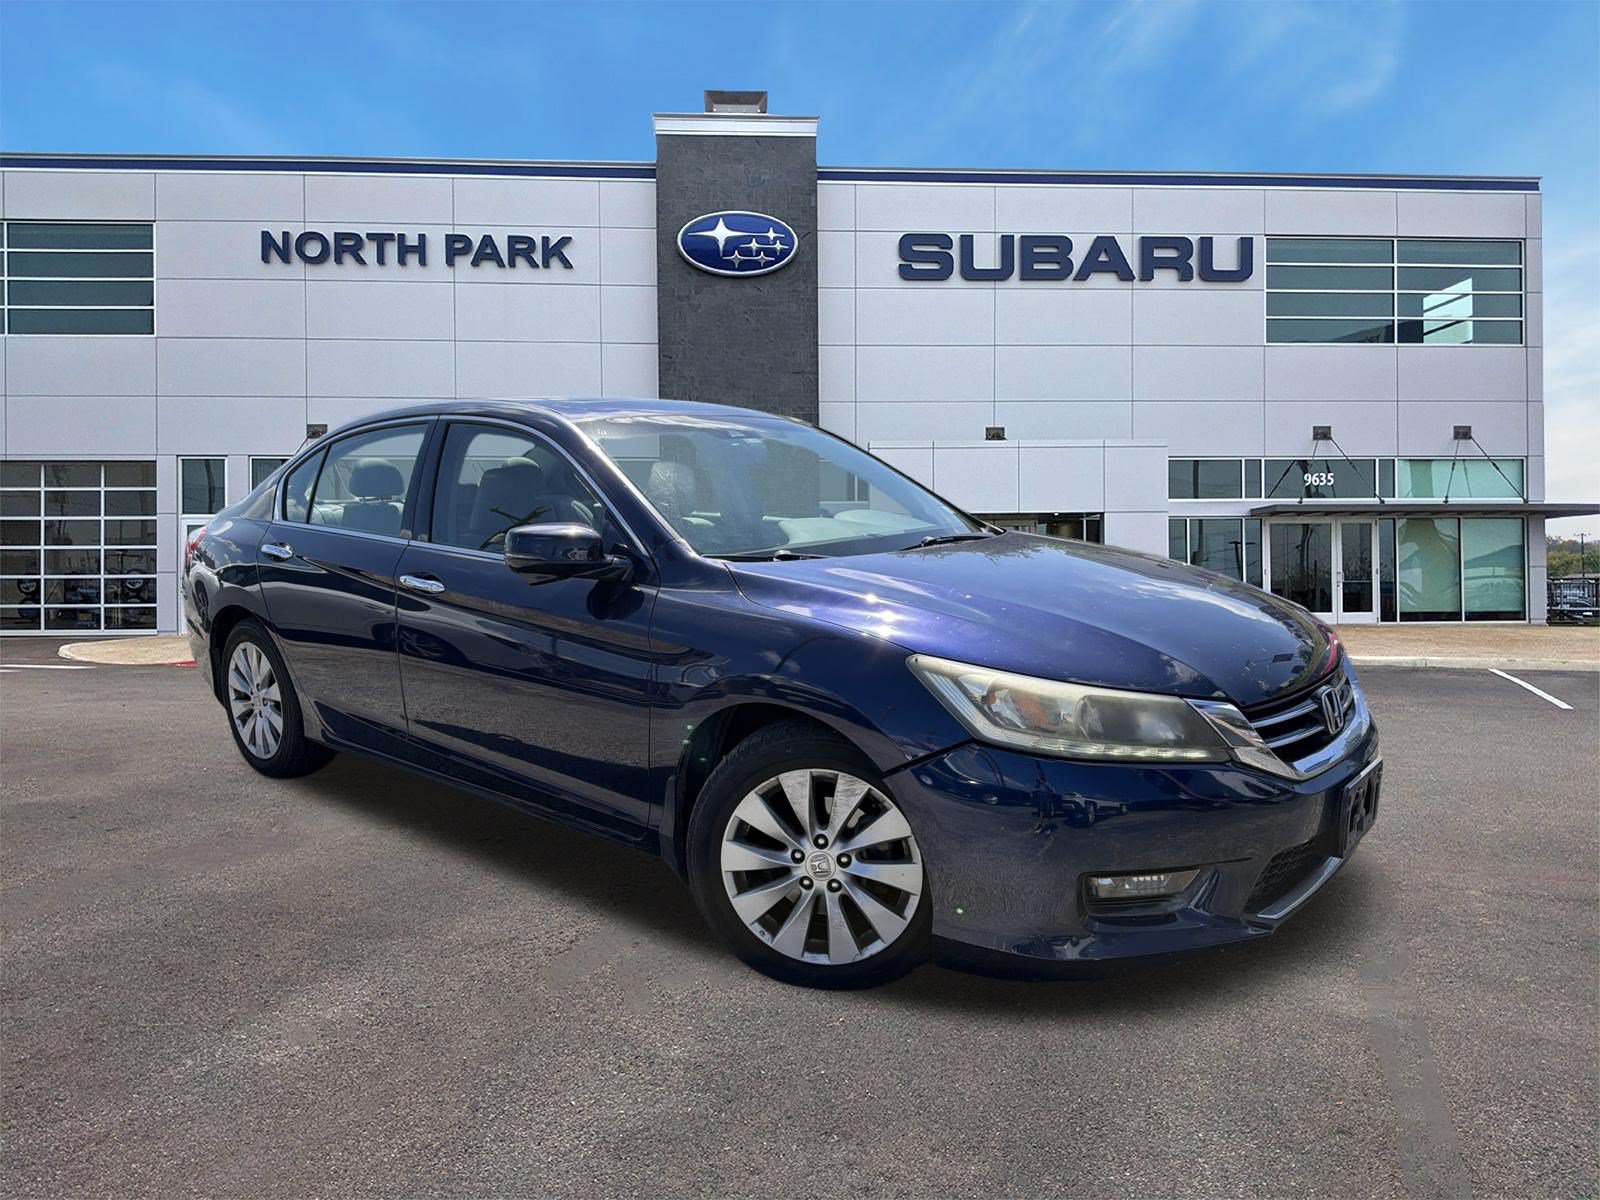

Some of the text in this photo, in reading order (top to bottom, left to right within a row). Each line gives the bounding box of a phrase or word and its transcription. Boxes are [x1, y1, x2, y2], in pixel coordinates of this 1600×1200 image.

[260, 230, 575, 270] NORTH PARK
[897, 233, 1254, 284] SUBARU
[1303, 472, 1335, 486] 9635
